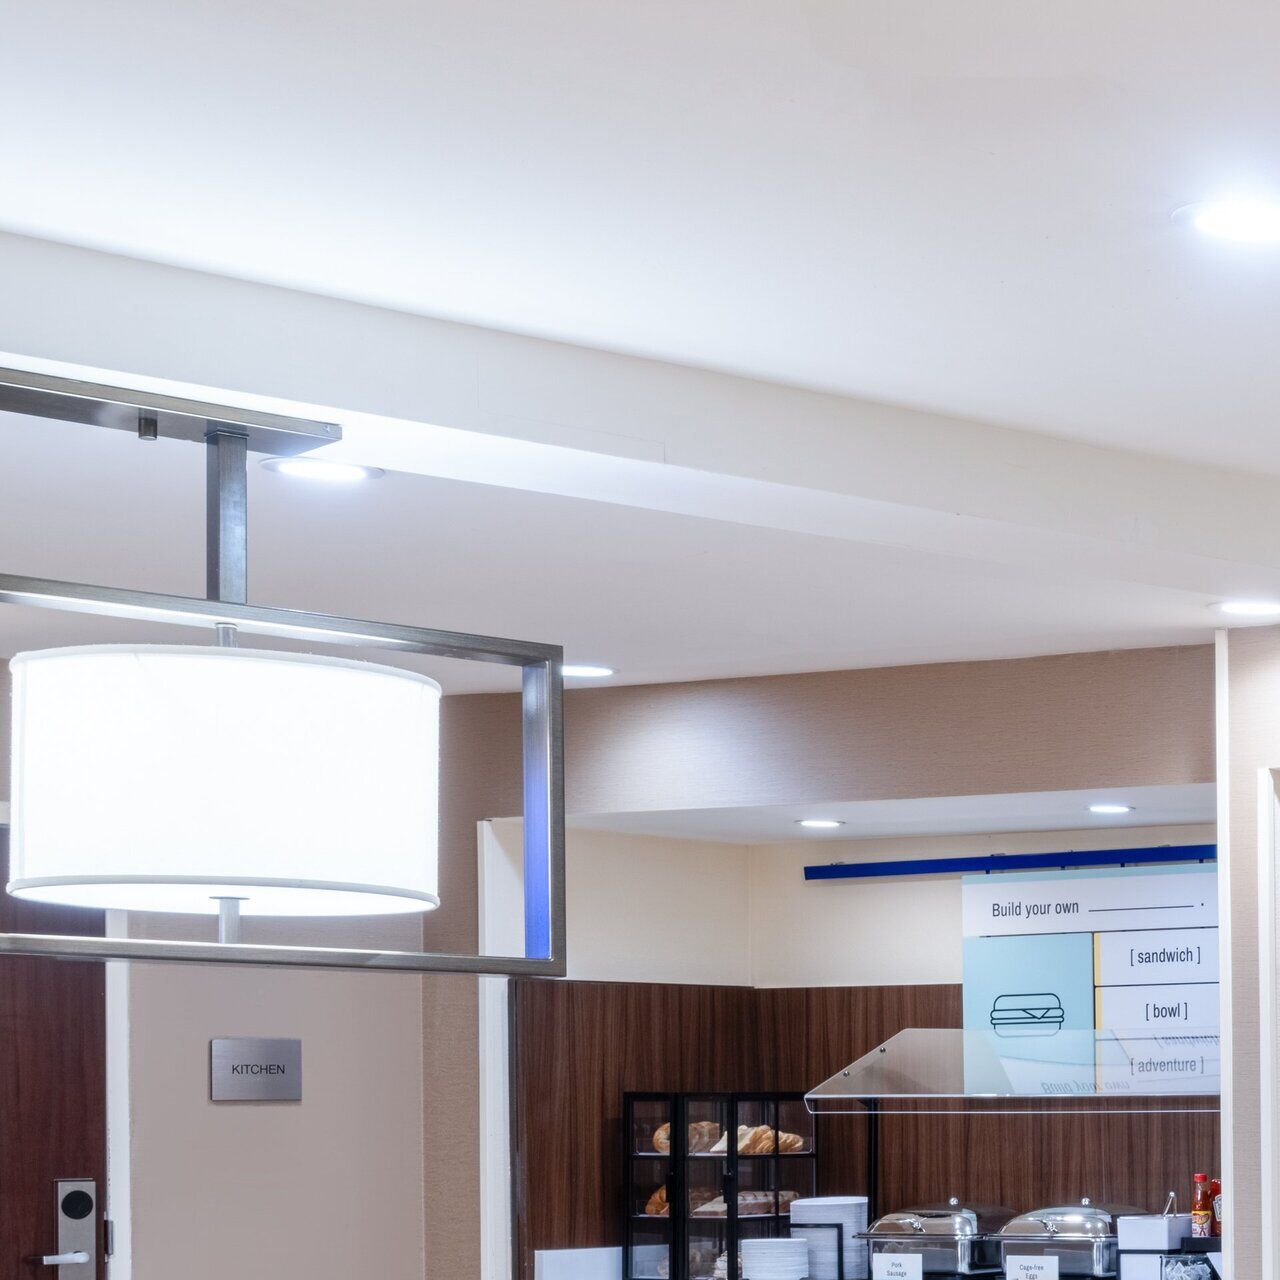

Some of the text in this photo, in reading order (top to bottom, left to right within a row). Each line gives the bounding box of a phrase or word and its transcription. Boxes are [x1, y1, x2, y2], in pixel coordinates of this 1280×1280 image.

[992, 901, 1079, 918] Build your own
[231, 1064, 286, 1075] KITCHEN
[1019, 1264, 1044, 1272] Cage-free
[1025, 1272, 1038, 1280] Eggs
